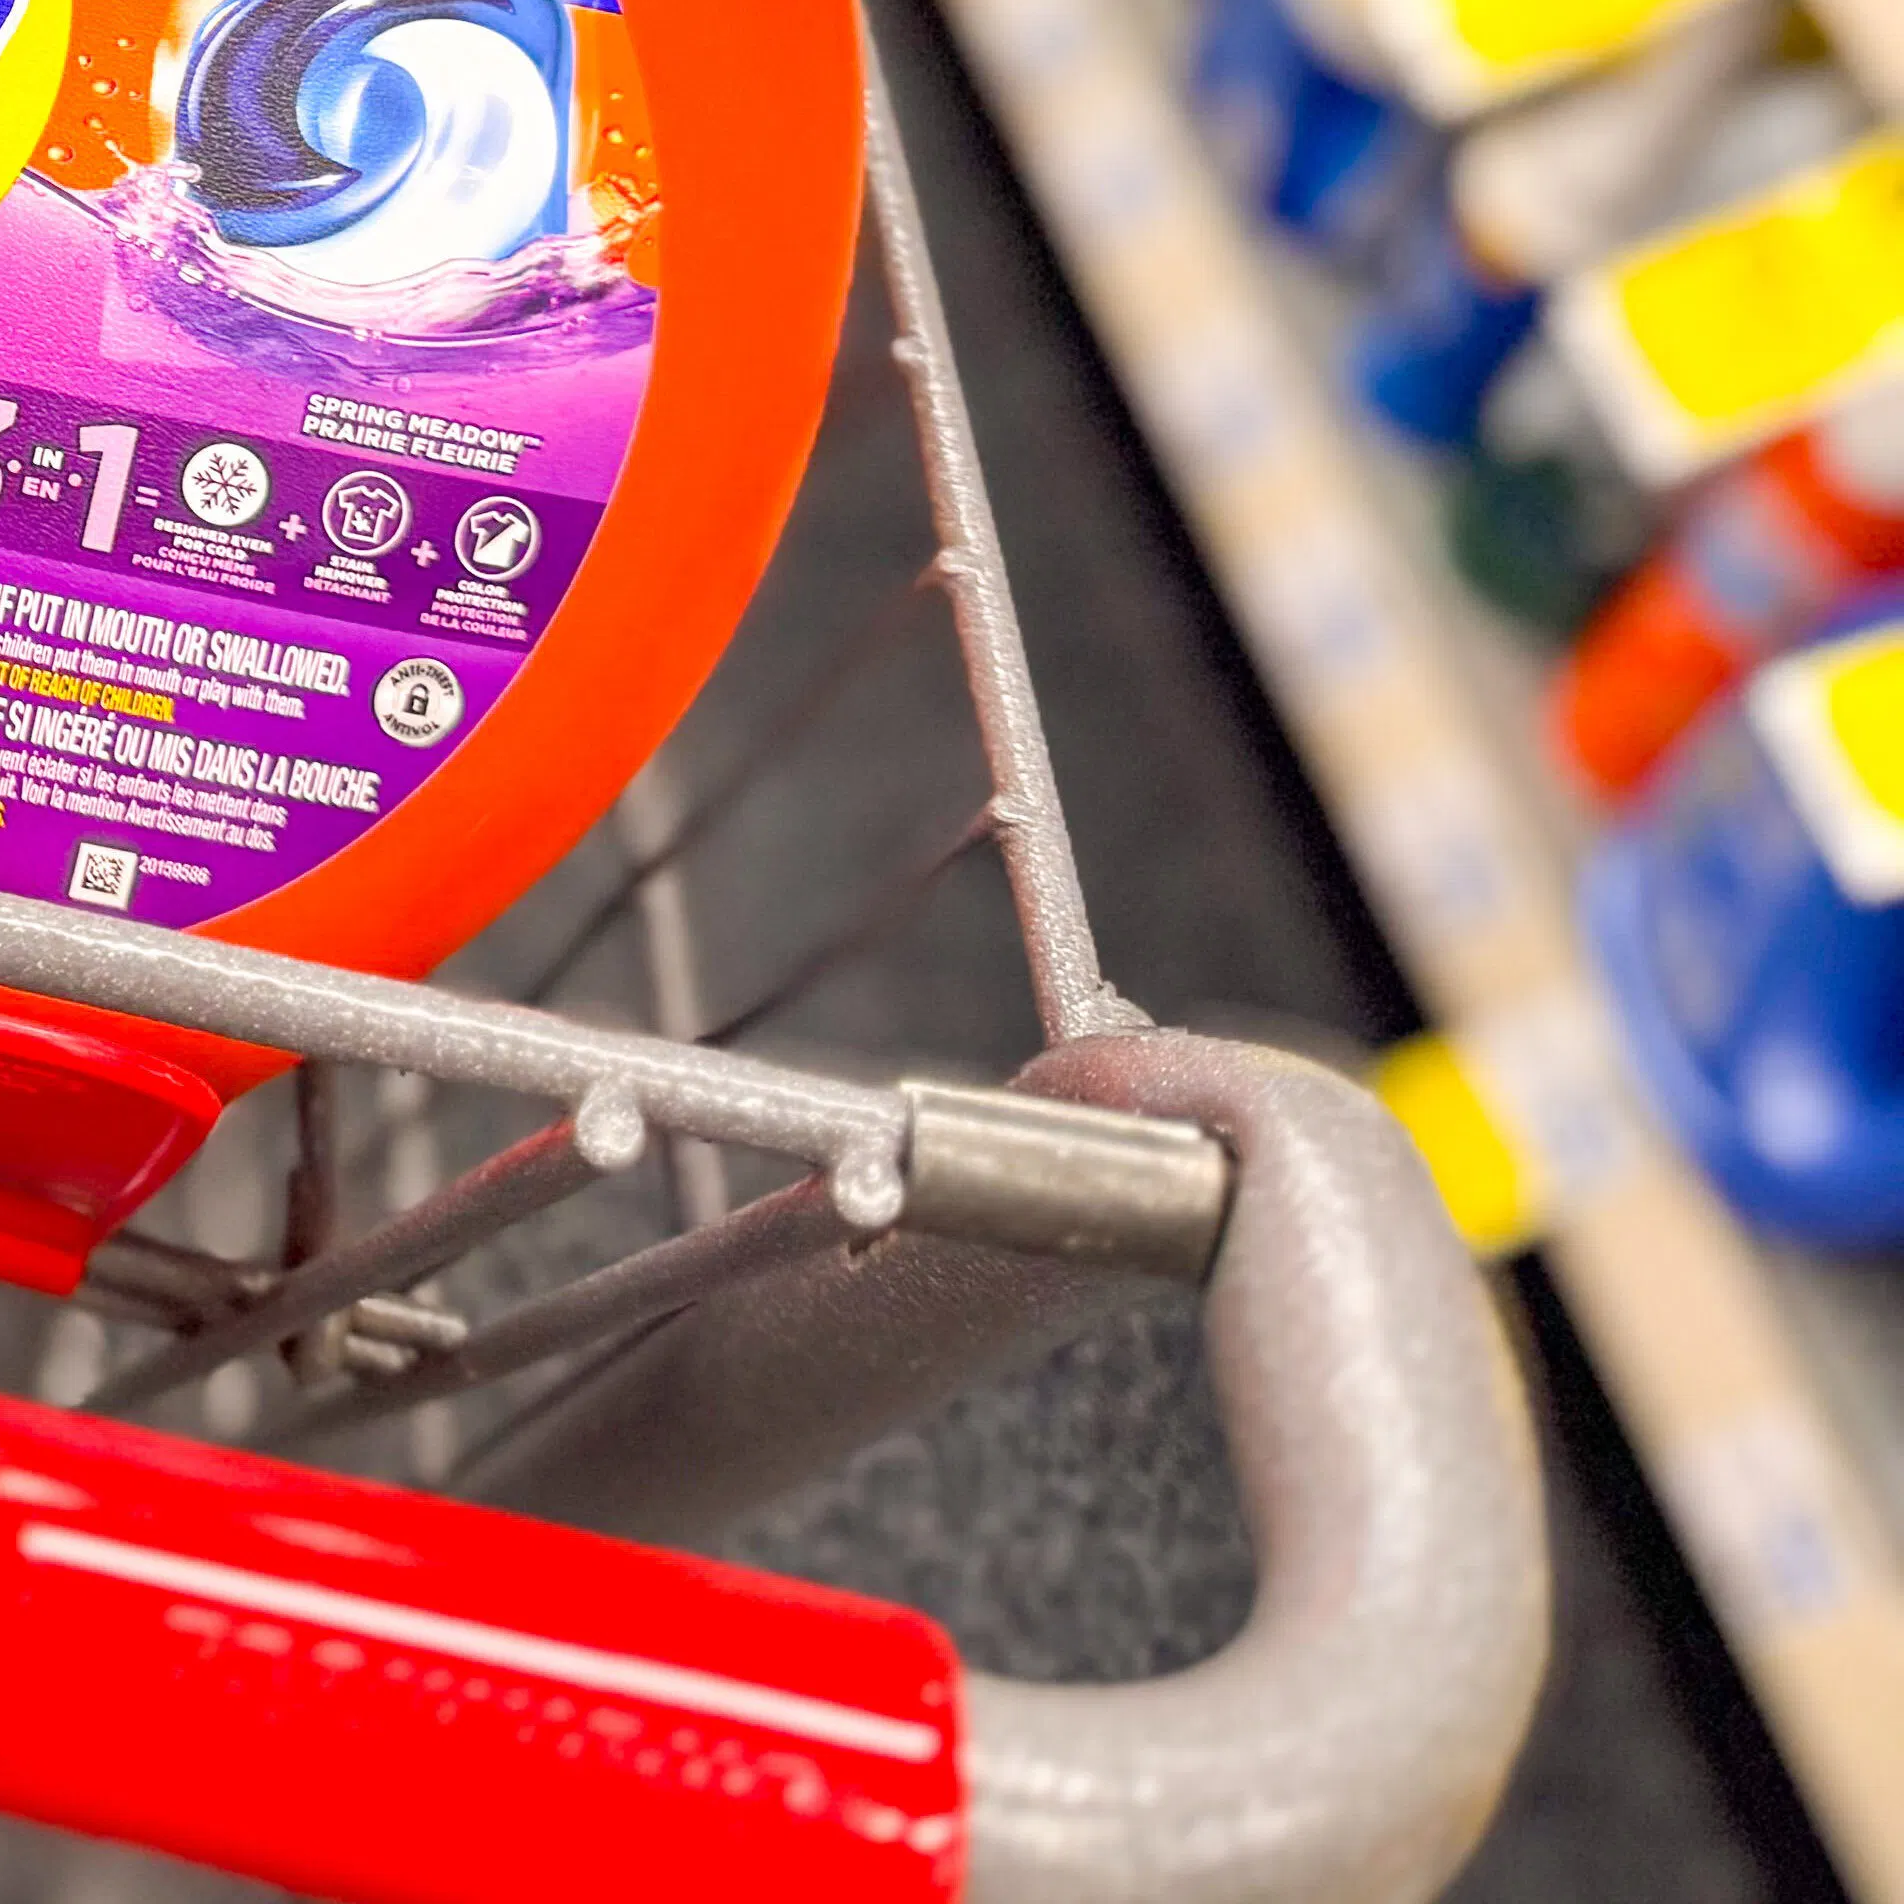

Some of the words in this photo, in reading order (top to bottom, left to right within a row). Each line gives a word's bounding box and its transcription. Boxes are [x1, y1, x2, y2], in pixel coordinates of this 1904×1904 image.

[307, 393, 405, 430] SPRING
[31, 444, 66, 472] IN
[302, 414, 408, 455] PRAIRIE
[410, 436, 519, 474] FLEURIE
[20, 475, 61, 503] EN
[153, 517, 230, 545] DESIGNED
[230, 534, 274, 554] EVEN
[173, 535, 206, 553] FOR
[205, 542, 249, 562] COLD
[131, 553, 175, 573] POUR
[220, 573, 276, 595] FROIDE
[314, 565, 390, 591] REMOVER
[329, 554, 376, 574] STAIN
[435, 588, 528, 615] PROTECTION
[457, 579, 508, 598] COLOR
[431, 600, 521, 626] PROTECTION
[14, 589, 65, 634] PUT
[61, 599, 92, 642] IN
[88, 605, 175, 659] MOUTH
[172, 623, 209, 667] OR
[206, 631, 350, 696] SWALLOWED.
[461, 620, 528, 642] COULEUR
[9, 664, 34, 690] OF
[29, 668, 81, 702] REACH
[77, 649, 118, 680] them
[134, 666, 182, 694] mouth
[198, 676, 233, 709] play
[232, 683, 267, 710] with
[264, 688, 304, 719] them.
[5, 700, 33, 742] SI
[31, 706, 119, 761] INGÉRÉ
[114, 724, 152, 768] OU
[147, 731, 195, 777] MIS
[192, 740, 259, 790] DANS
[256, 753, 290, 796] LA
[65, 792, 126, 822] mention
